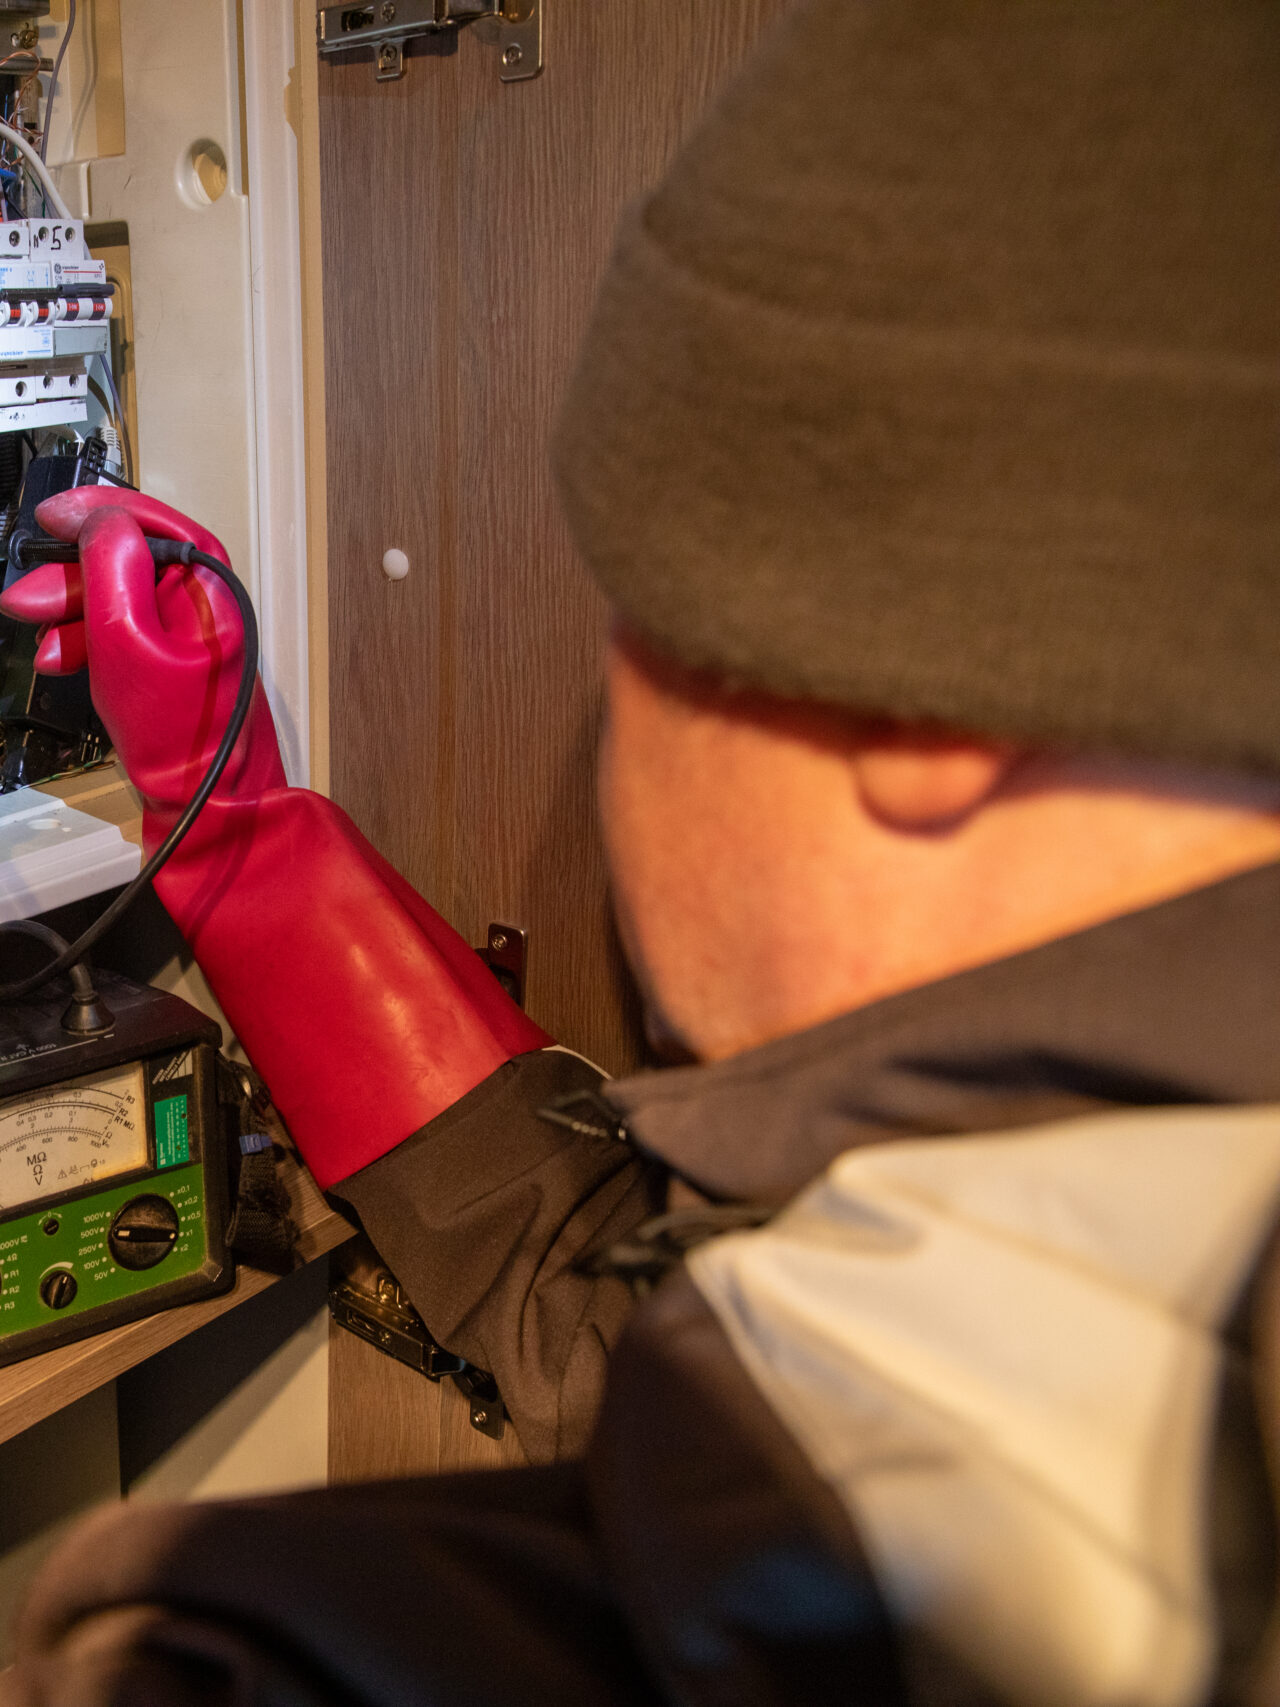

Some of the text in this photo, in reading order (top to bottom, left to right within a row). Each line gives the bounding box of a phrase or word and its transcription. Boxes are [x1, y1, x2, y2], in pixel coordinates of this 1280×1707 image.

[50, 225, 62, 251] 5
[126, 1095, 136, 1105] R3
[118, 1107, 129, 1117] R2
[114, 1115, 124, 1125] R1
[26, 1151, 48, 1167] MΩ
[32, 1164, 43, 1176] Ω
[34, 1175, 43, 1186] V
[83, 1212, 105, 1223] 1000V
[80, 1227, 100, 1239] 500V
[78, 1244, 97, 1256] 250V
[83, 1259, 100, 1270] 100V
[9, 1269, 19, 1278] R1
[94, 1271, 109, 1281] 50V
[9, 1285, 20, 1295] R2
[4, 1301, 16, 1311] R3
